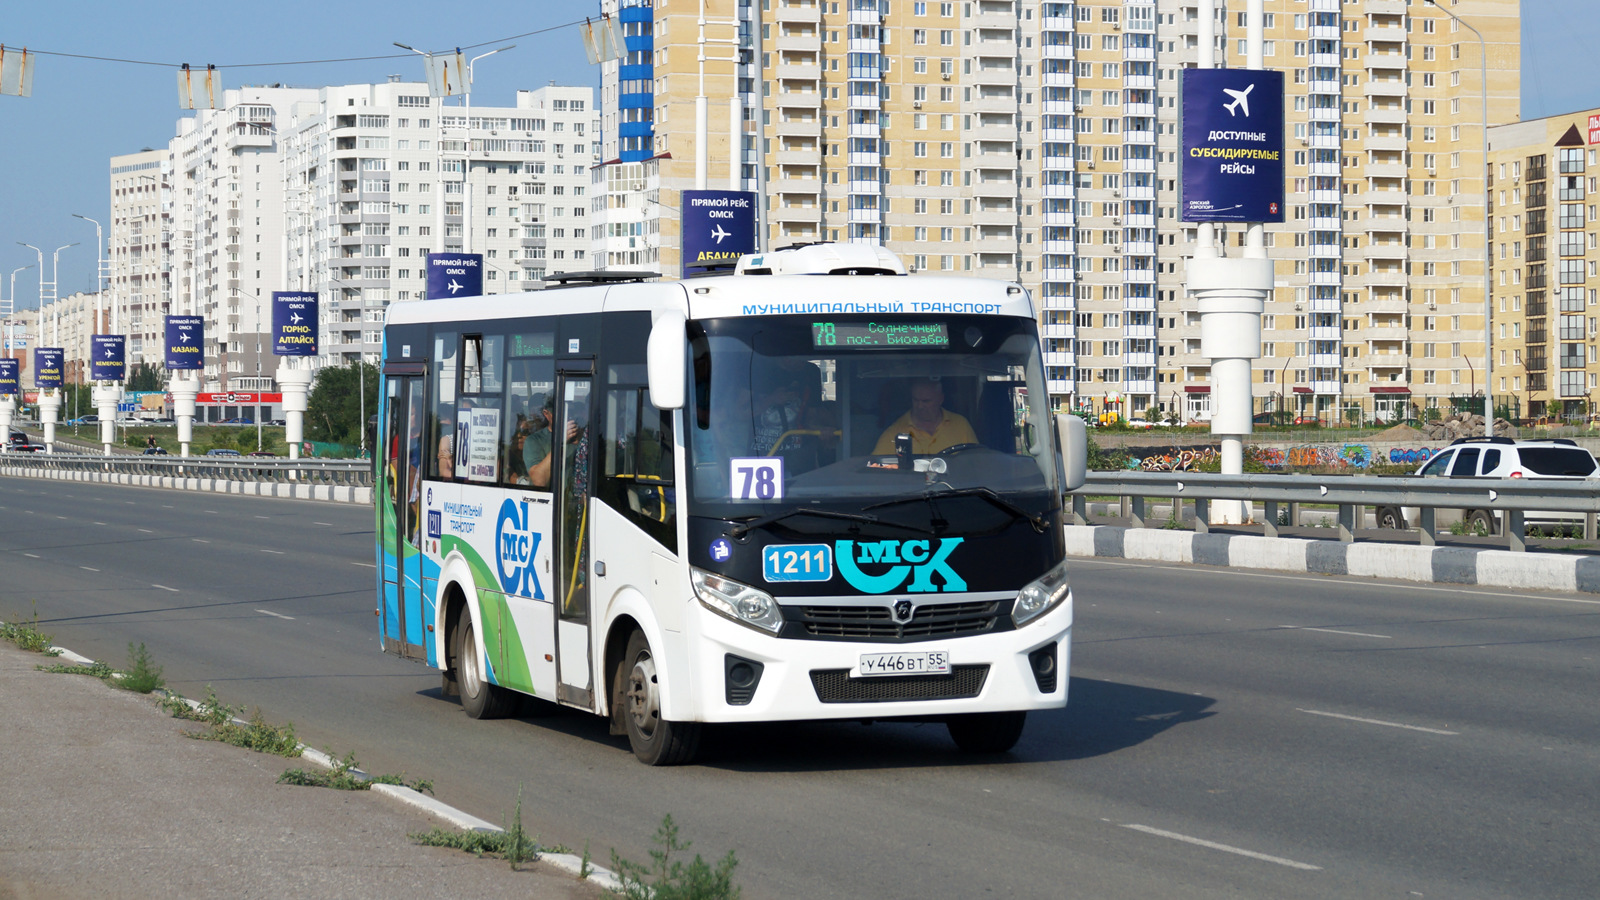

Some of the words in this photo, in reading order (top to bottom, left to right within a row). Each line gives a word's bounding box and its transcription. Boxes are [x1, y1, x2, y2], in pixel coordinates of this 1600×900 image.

[1589, 115, 1600, 130] ЛЬ
[1208, 130, 1266, 142] ДОСТУПНЫЕ
[1190, 148, 1279, 160] СУБСИДИРУЕМЫЕ
[1220, 162, 1255, 174] РЕЙСЫ
[692, 198, 728, 206] ПРЯМОЙ
[730, 199, 748, 208] РЕЙС
[742, 300, 904, 315] МУНИЦИПАЛЬНЫЙ
[910, 302, 1002, 314] ТРАНСПОРТ
[812, 322, 836, 346] 78
[868, 322, 942, 333] Солнечный
[279, 335, 314, 344] АЛТАЙСК
[846, 336, 878, 344] пос.
[457, 422, 469, 466] 78
[738, 466, 775, 500] 78
[444, 501, 482, 517] МУНИЦИПАЛЬНЫЙ
[450, 520, 475, 534] ТРАНСПОРТ
[768, 550, 825, 574] 1211
[929, 654, 942, 665] 55
